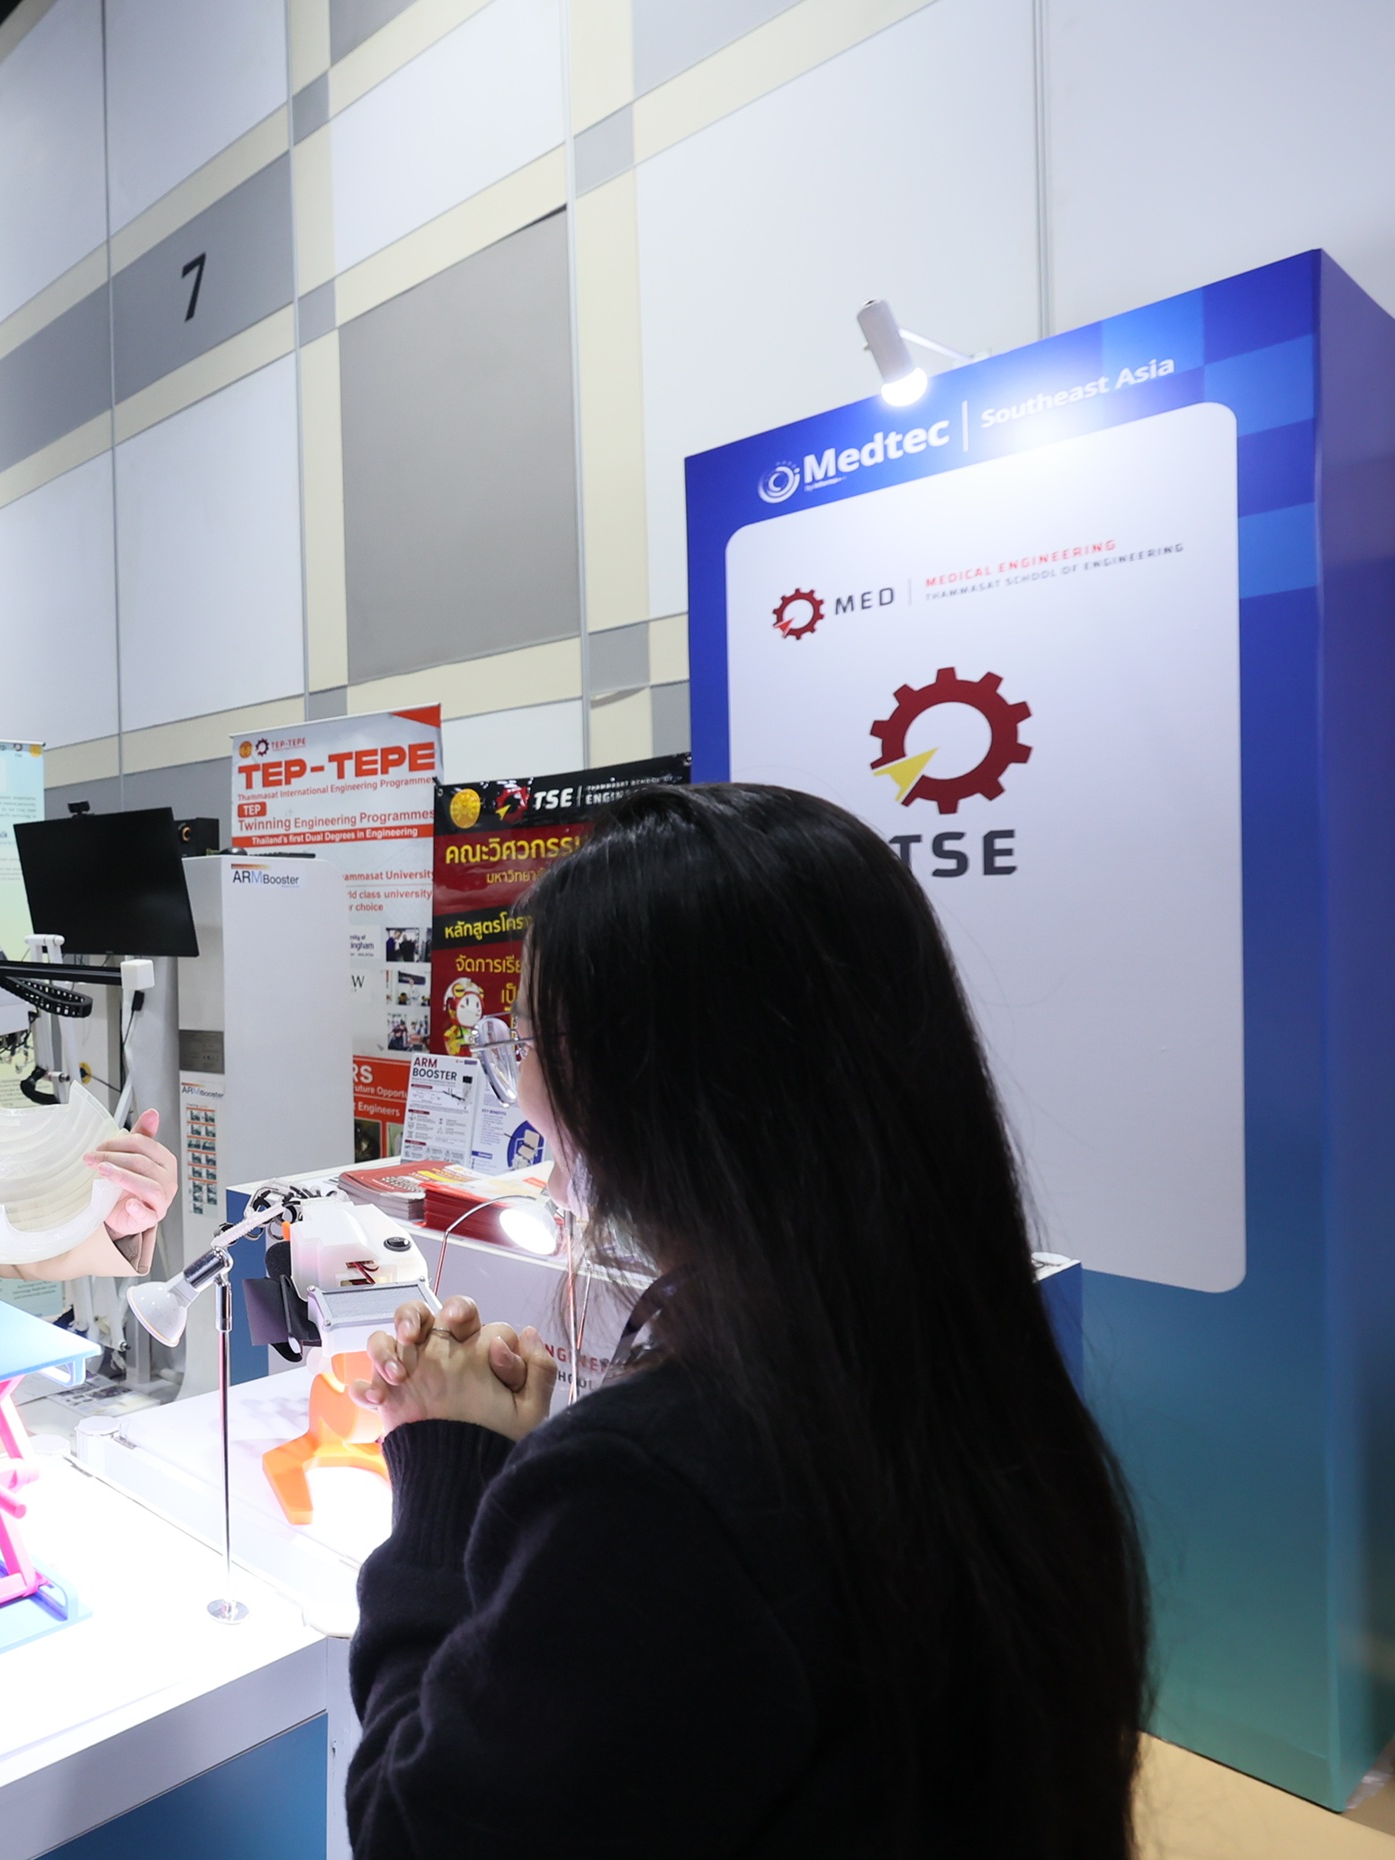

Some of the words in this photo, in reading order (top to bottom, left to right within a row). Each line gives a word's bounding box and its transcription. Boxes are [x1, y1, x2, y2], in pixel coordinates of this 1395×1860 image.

[181, 251, 207, 323] 7
[980, 375, 1109, 429] Southeast
[1114, 358, 1175, 390] Asia
[803, 419, 950, 485] Medtec
[925, 566, 992, 588] MEDICAL
[998, 539, 1116, 573] ENGINEERING
[925, 579, 1001, 601] THAMMASAT
[1005, 569, 1056, 587] SCHOOL
[1061, 564, 1079, 576] OF
[1083, 543, 1185, 571] ENGINEERING
[834, 586, 895, 615] MED
[271, 737, 307, 748] TEP-TEPE
[238, 742, 435, 790] TEP-TEPE
[238, 791, 279, 801] Thammasat
[280, 786, 329, 799] International
[330, 781, 378, 794] Engineering
[534, 787, 574, 811] TSE
[243, 804, 261, 816] TEP
[238, 818, 292, 832] Twinning
[294, 815, 356, 830] Engineering
[360, 810, 435, 826] Programmes
[252, 835, 287, 846] Thailand's
[289, 833, 304, 843] first
[306, 831, 323, 842] Dual
[324, 830, 355, 843] Degrees
[357, 829, 365, 839] in
[366, 828, 418, 841] Engineering
[888, 829, 1018, 878] TSE
[343, 871, 383, 882] ammasat
[359, 889, 381, 899] class
[355, 902, 384, 912] choice
[350, 942, 374, 951] ingham
[413, 1057, 438, 1068] ARM
[412, 1067, 458, 1081] BOOSTER
[354, 1085, 375, 1094] uture
[358, 1101, 401, 1117] Engineers
